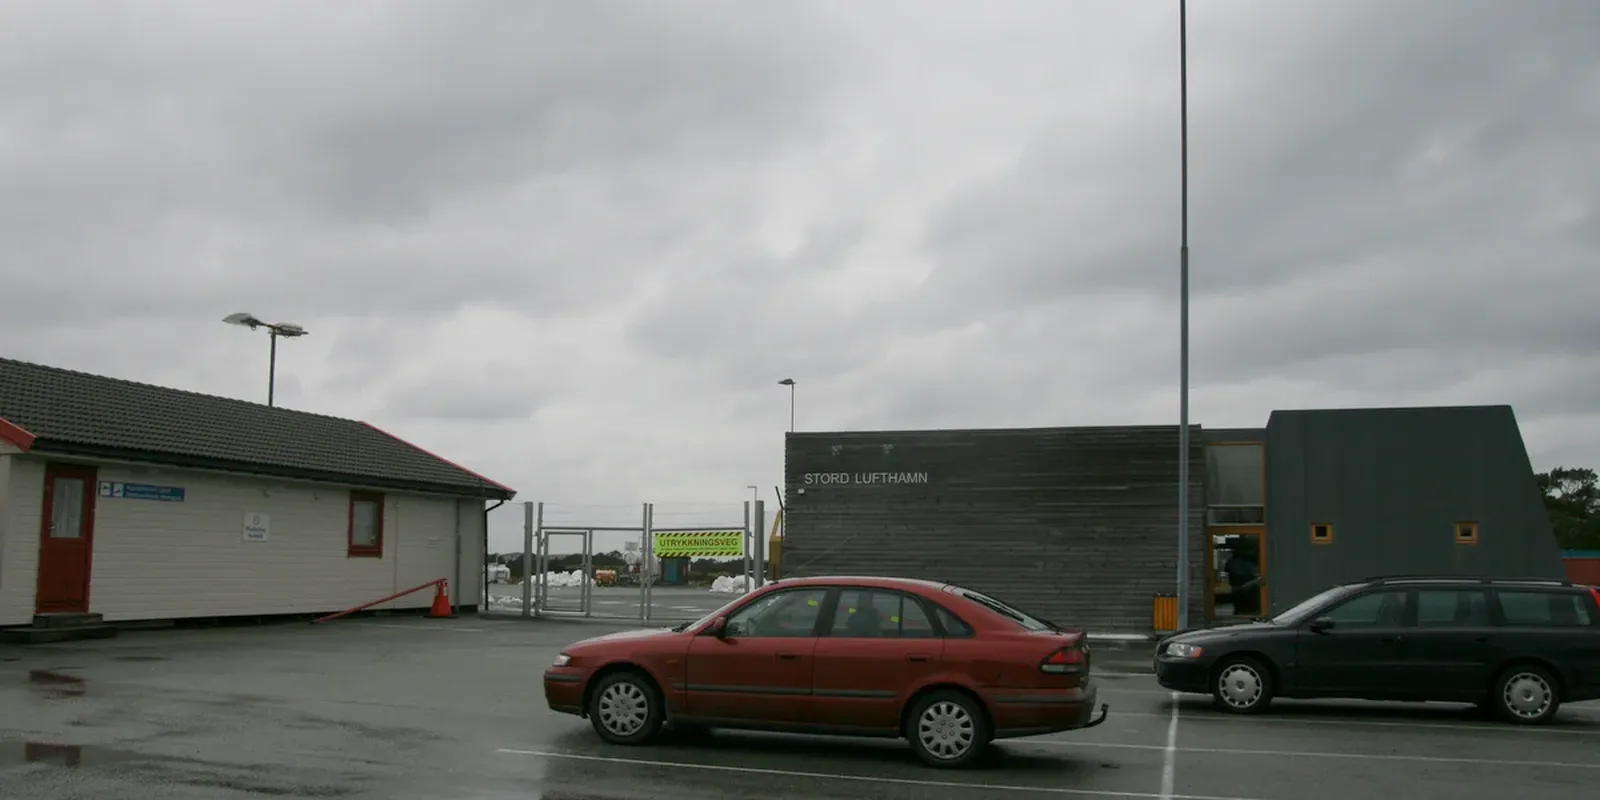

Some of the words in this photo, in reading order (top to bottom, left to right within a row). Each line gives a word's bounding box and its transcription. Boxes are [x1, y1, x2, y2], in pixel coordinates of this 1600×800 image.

[804, 472, 850, 485] STORD
[855, 472, 928, 484] LUFTHAMN
[659, 538, 738, 547] UTRYKKNINGSVEG
